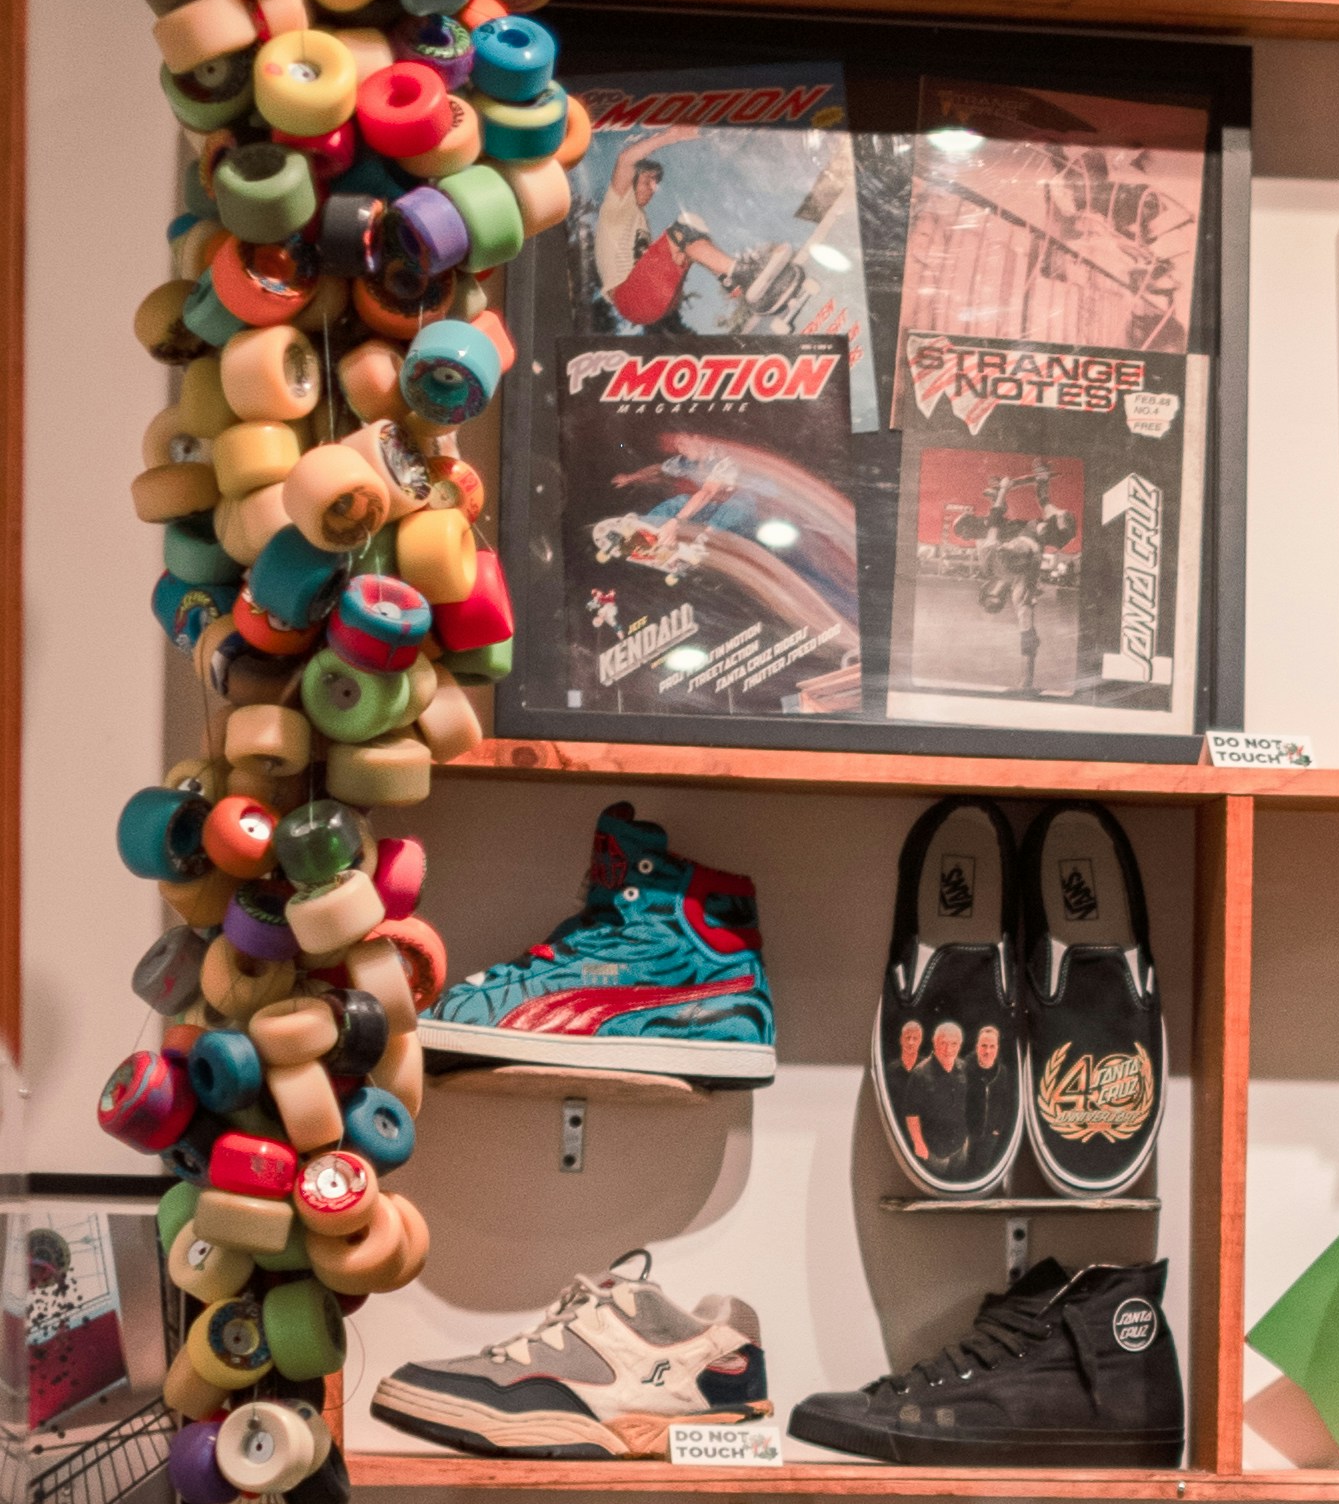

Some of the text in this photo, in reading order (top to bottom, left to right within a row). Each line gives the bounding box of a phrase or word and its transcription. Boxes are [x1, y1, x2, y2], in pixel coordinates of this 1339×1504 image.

[592, 84, 833, 132] MOTION
[599, 353, 842, 403] MOTION
[915, 345, 1146, 389] STRANGE
[953, 373, 1117, 411] NOTES
[616, 401, 749, 415] MAGAZINE
[1123, 473, 1164, 683] SANTA CRUZ
[598, 601, 700, 688] KENDALL
[1213, 736, 1283, 750] DO NOT
[1215, 750, 1281, 765] TOUCH
[1089, 1059, 1140, 1087] SANTA
[1096, 1079, 1140, 1105] CRUZ
[1115, 1309, 1153, 1326] SANTA
[674, 1430, 750, 1443] DO NOT
[675, 1446, 746, 1459] TOUCH
